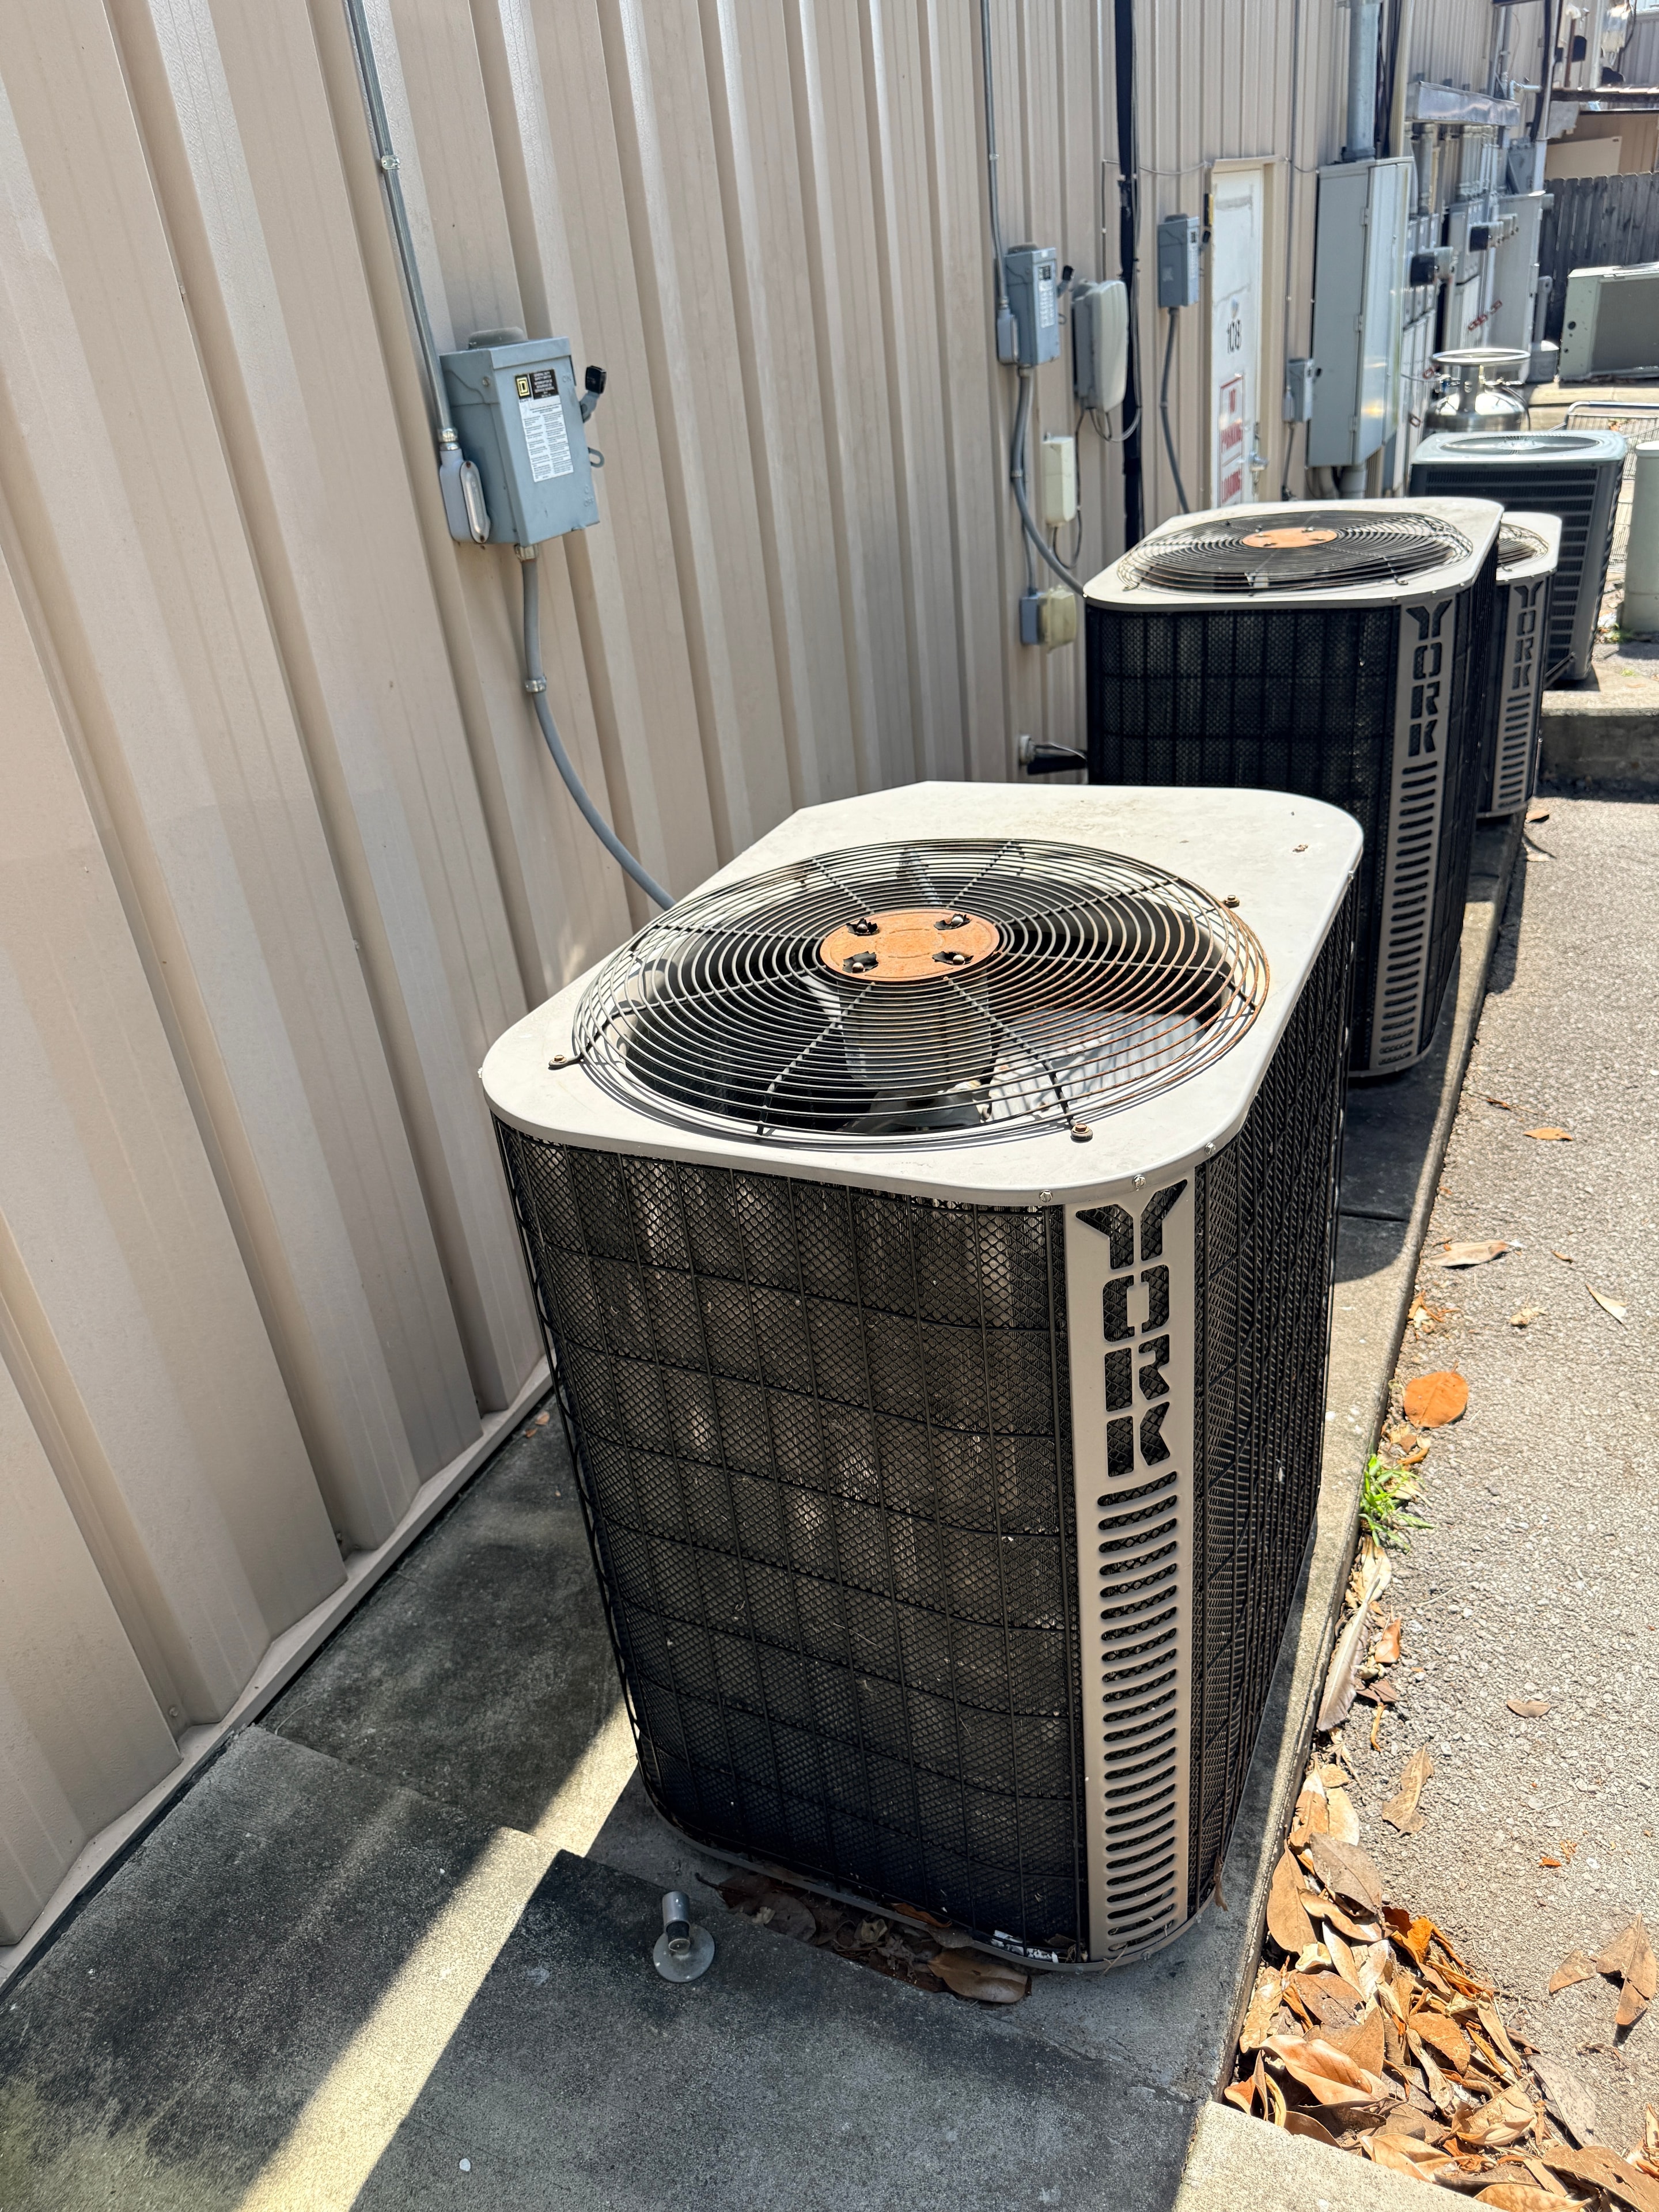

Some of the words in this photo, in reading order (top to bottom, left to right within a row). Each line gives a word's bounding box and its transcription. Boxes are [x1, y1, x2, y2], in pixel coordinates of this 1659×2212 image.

[1226, 319, 1242, 354] 108
[1406, 599, 1453, 757] YORK
[1513, 581, 1544, 690] YORK
[1075, 1180, 1188, 1478] YORK
